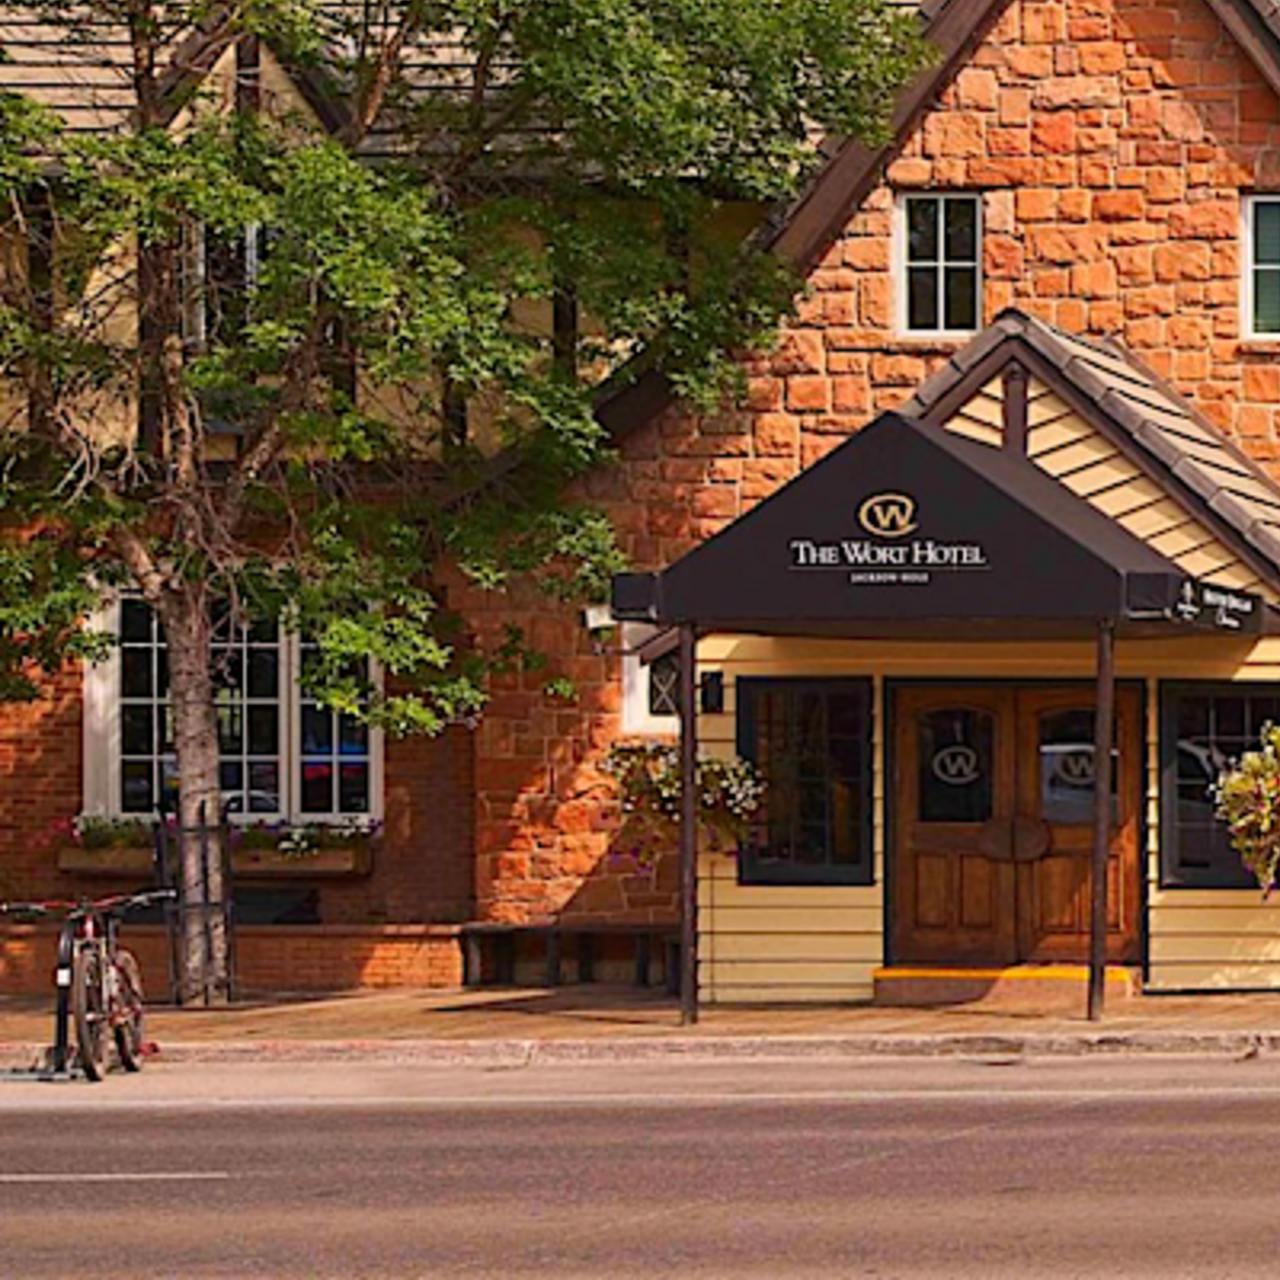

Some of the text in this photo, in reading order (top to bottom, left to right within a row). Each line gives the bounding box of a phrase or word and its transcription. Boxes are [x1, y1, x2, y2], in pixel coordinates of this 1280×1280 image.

[790, 541, 986, 564] THE WORT HOTEL
